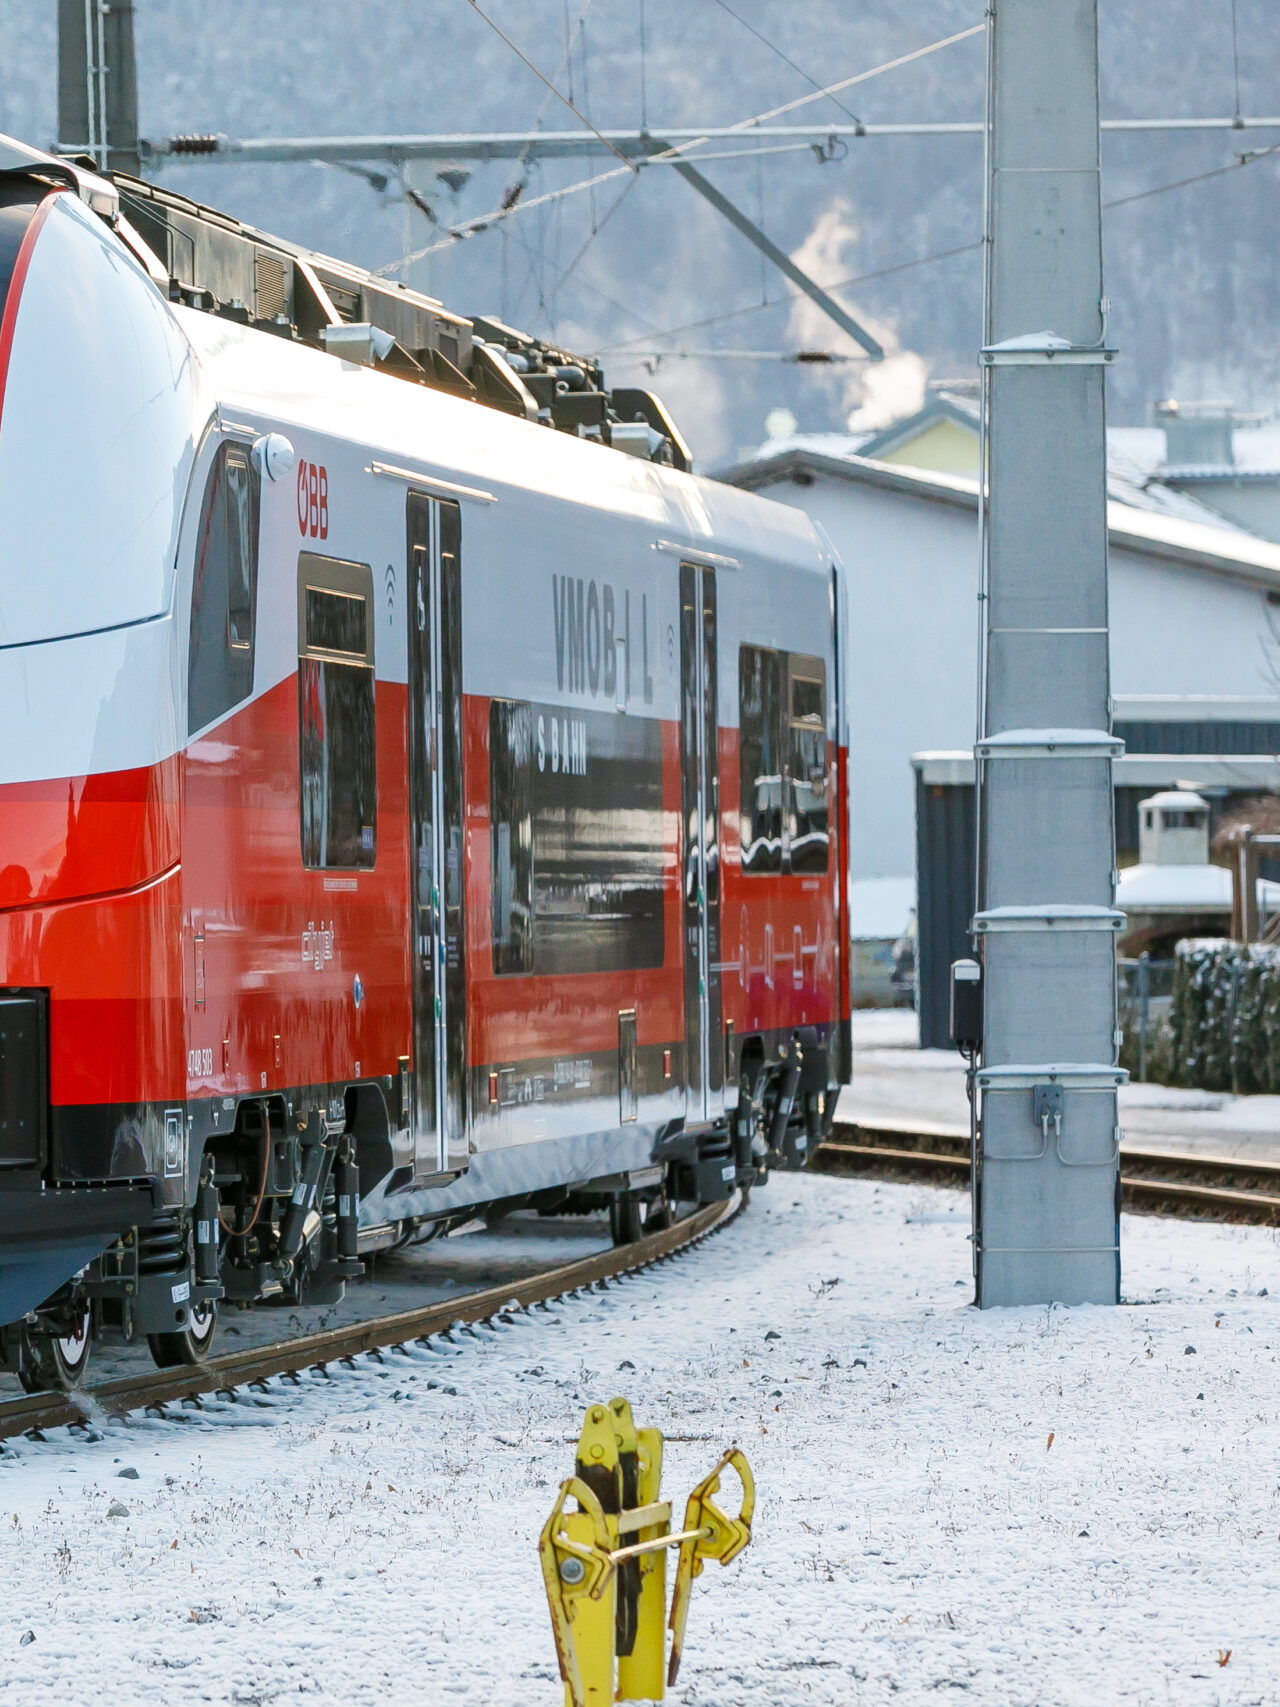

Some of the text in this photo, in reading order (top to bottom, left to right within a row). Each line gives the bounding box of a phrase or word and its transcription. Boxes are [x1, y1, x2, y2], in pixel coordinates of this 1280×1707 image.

[297, 458, 329, 540] ÖBB
[537, 714, 587, 777] S BAHN
